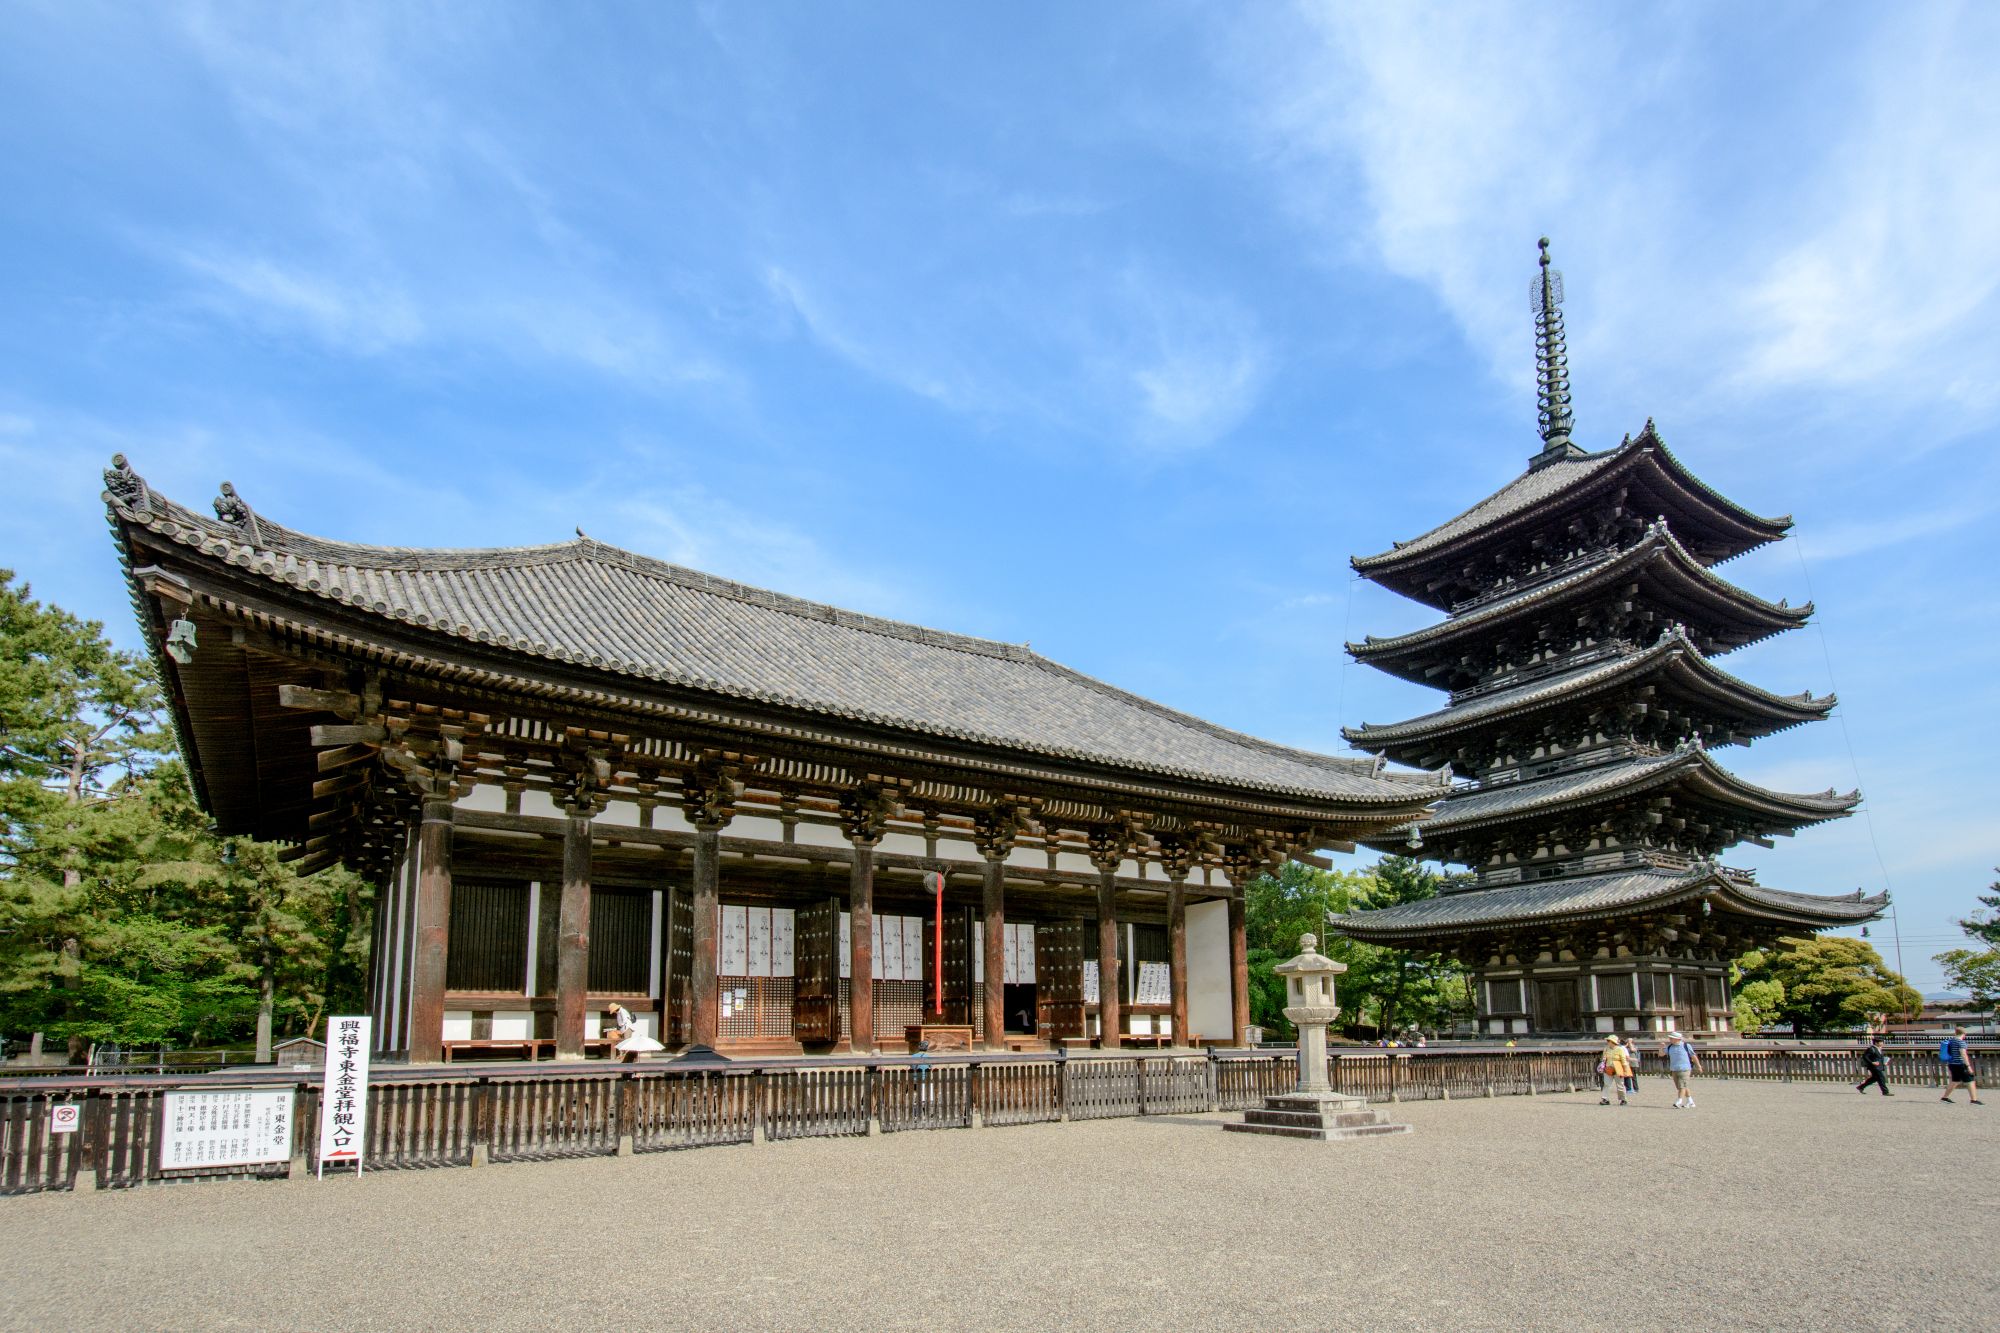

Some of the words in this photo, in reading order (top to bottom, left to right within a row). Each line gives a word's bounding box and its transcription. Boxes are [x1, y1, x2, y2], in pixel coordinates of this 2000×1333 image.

[332, 1020, 360, 1147] 興福寺東金堂拝観入口
